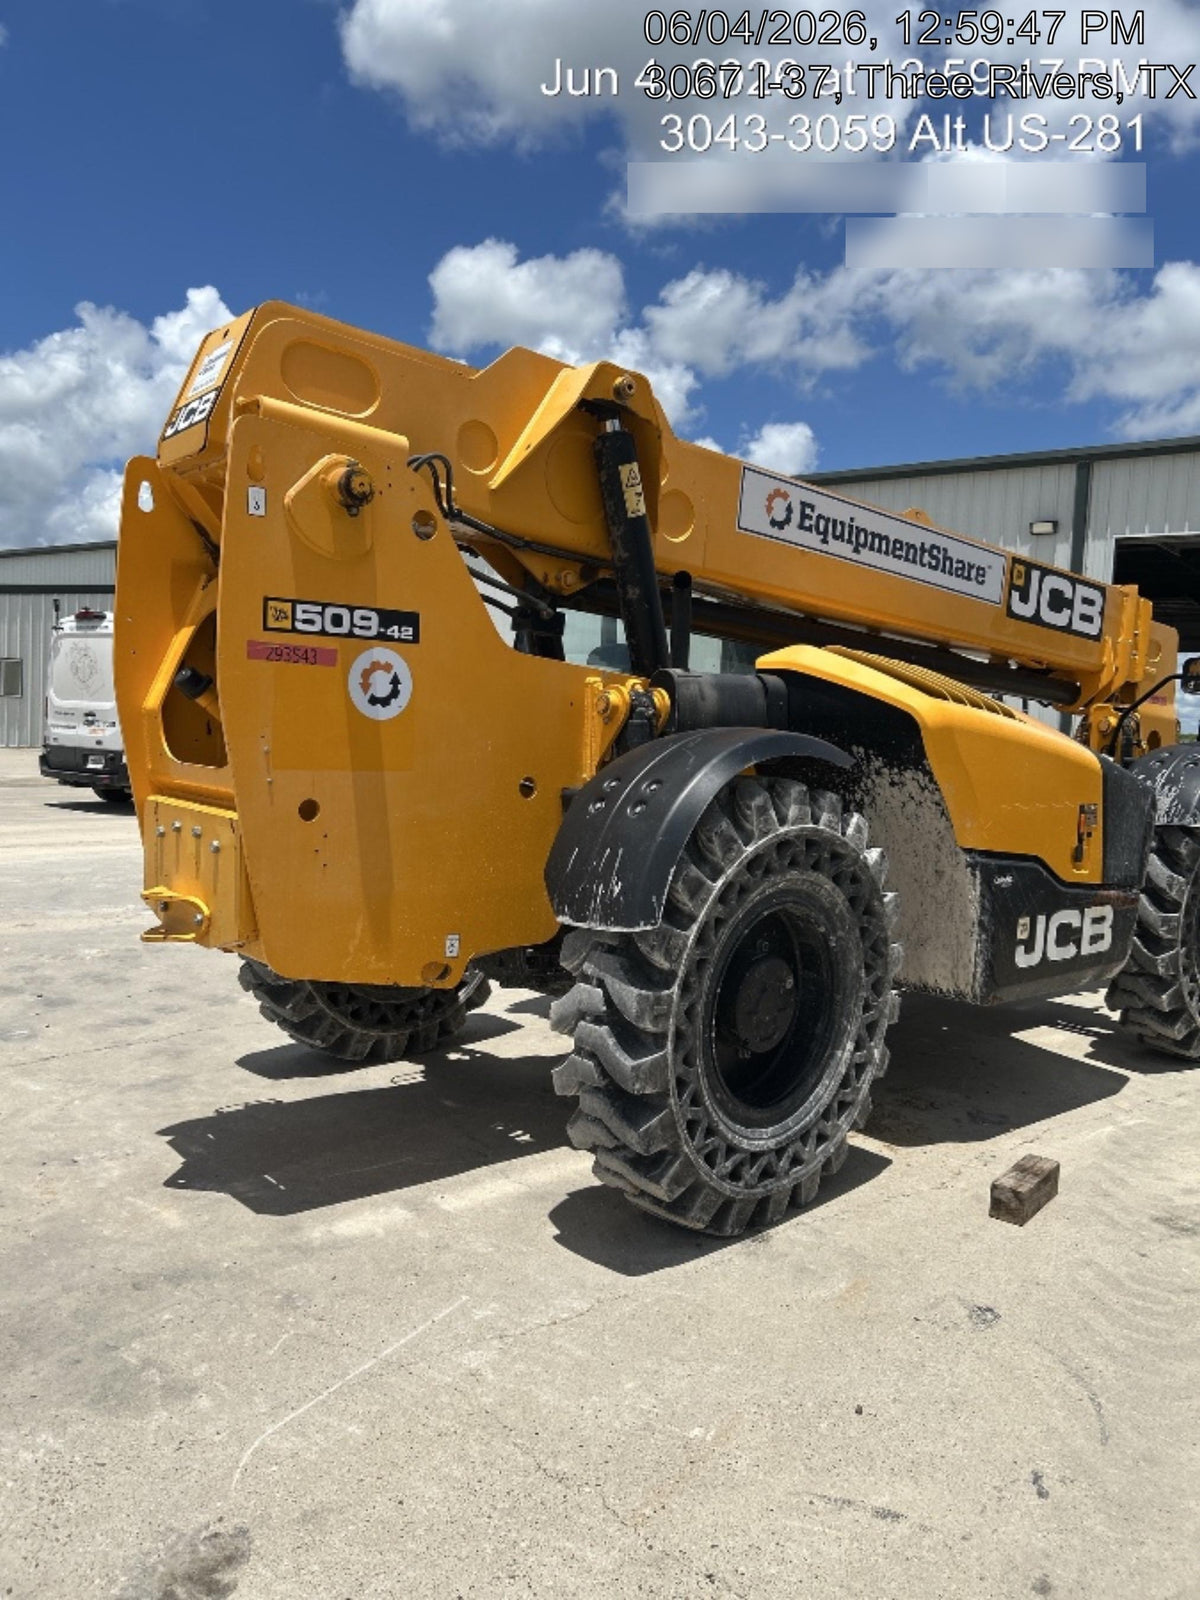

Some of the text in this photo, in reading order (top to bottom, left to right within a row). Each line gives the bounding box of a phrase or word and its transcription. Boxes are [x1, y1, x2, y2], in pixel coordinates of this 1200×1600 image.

[164, 390, 219, 437] JCB
[797, 500, 987, 586] EquipmentShare
[1010, 569, 1105, 637] JCB
[1015, 904, 1114, 968] JCB
